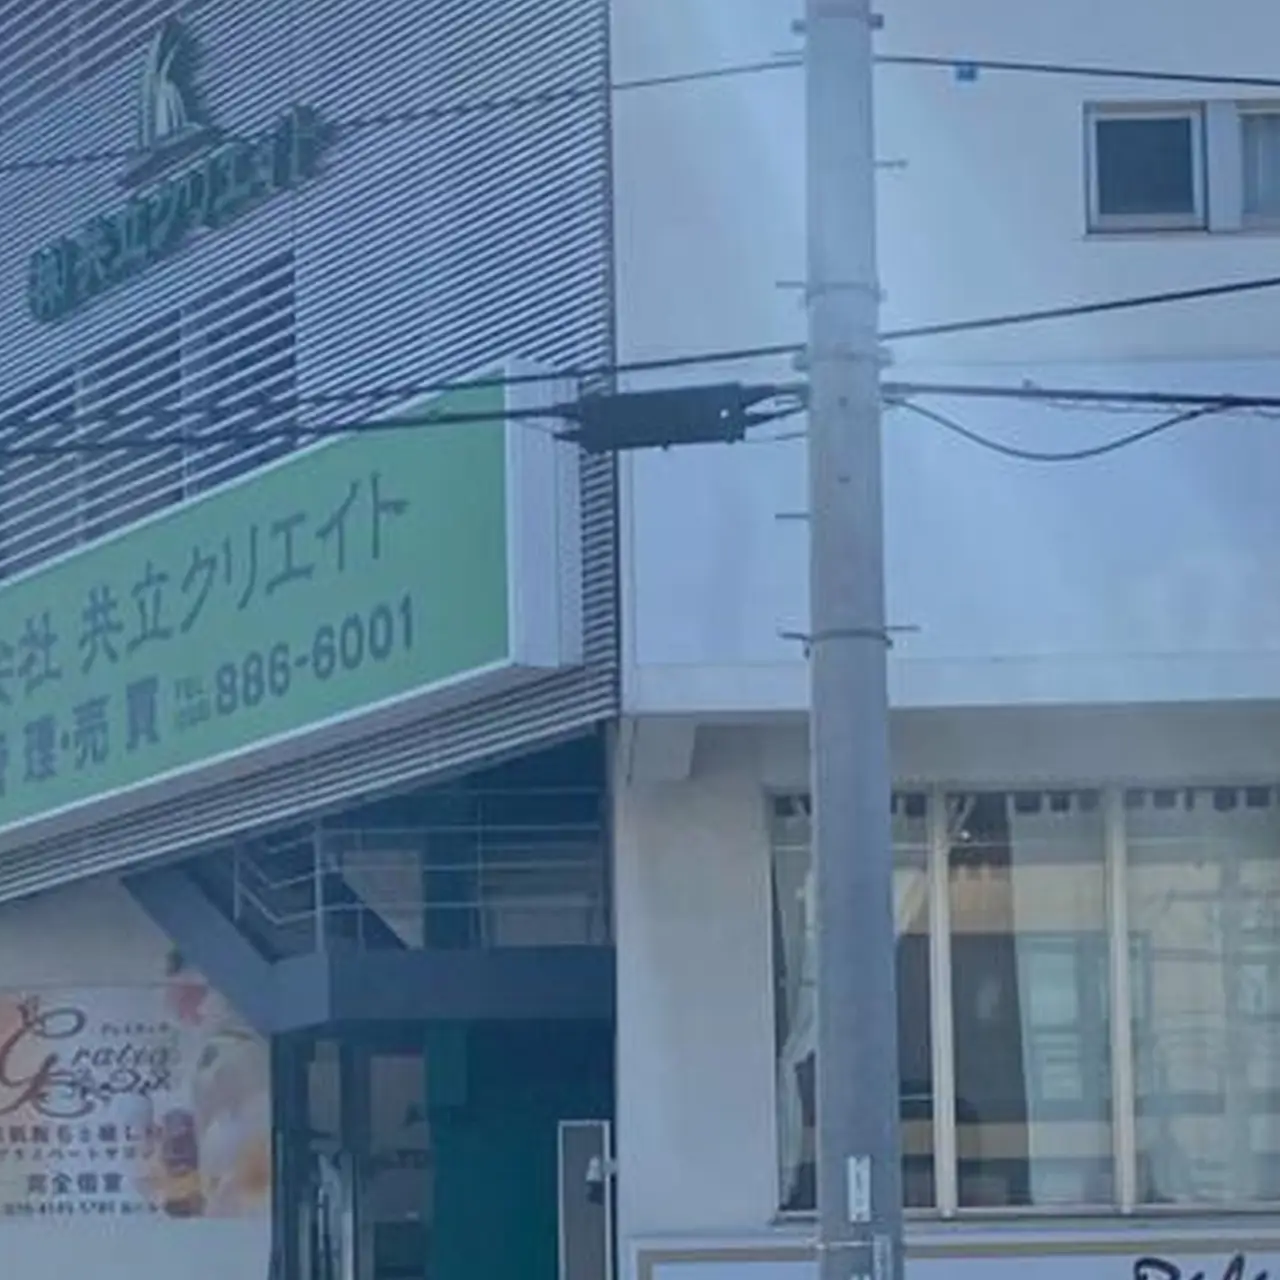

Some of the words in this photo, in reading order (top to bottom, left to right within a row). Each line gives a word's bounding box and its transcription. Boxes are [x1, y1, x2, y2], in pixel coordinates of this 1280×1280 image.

[78, 472, 410, 674] 共立クリエイト
[215, 593, 414, 716] 886-6001
